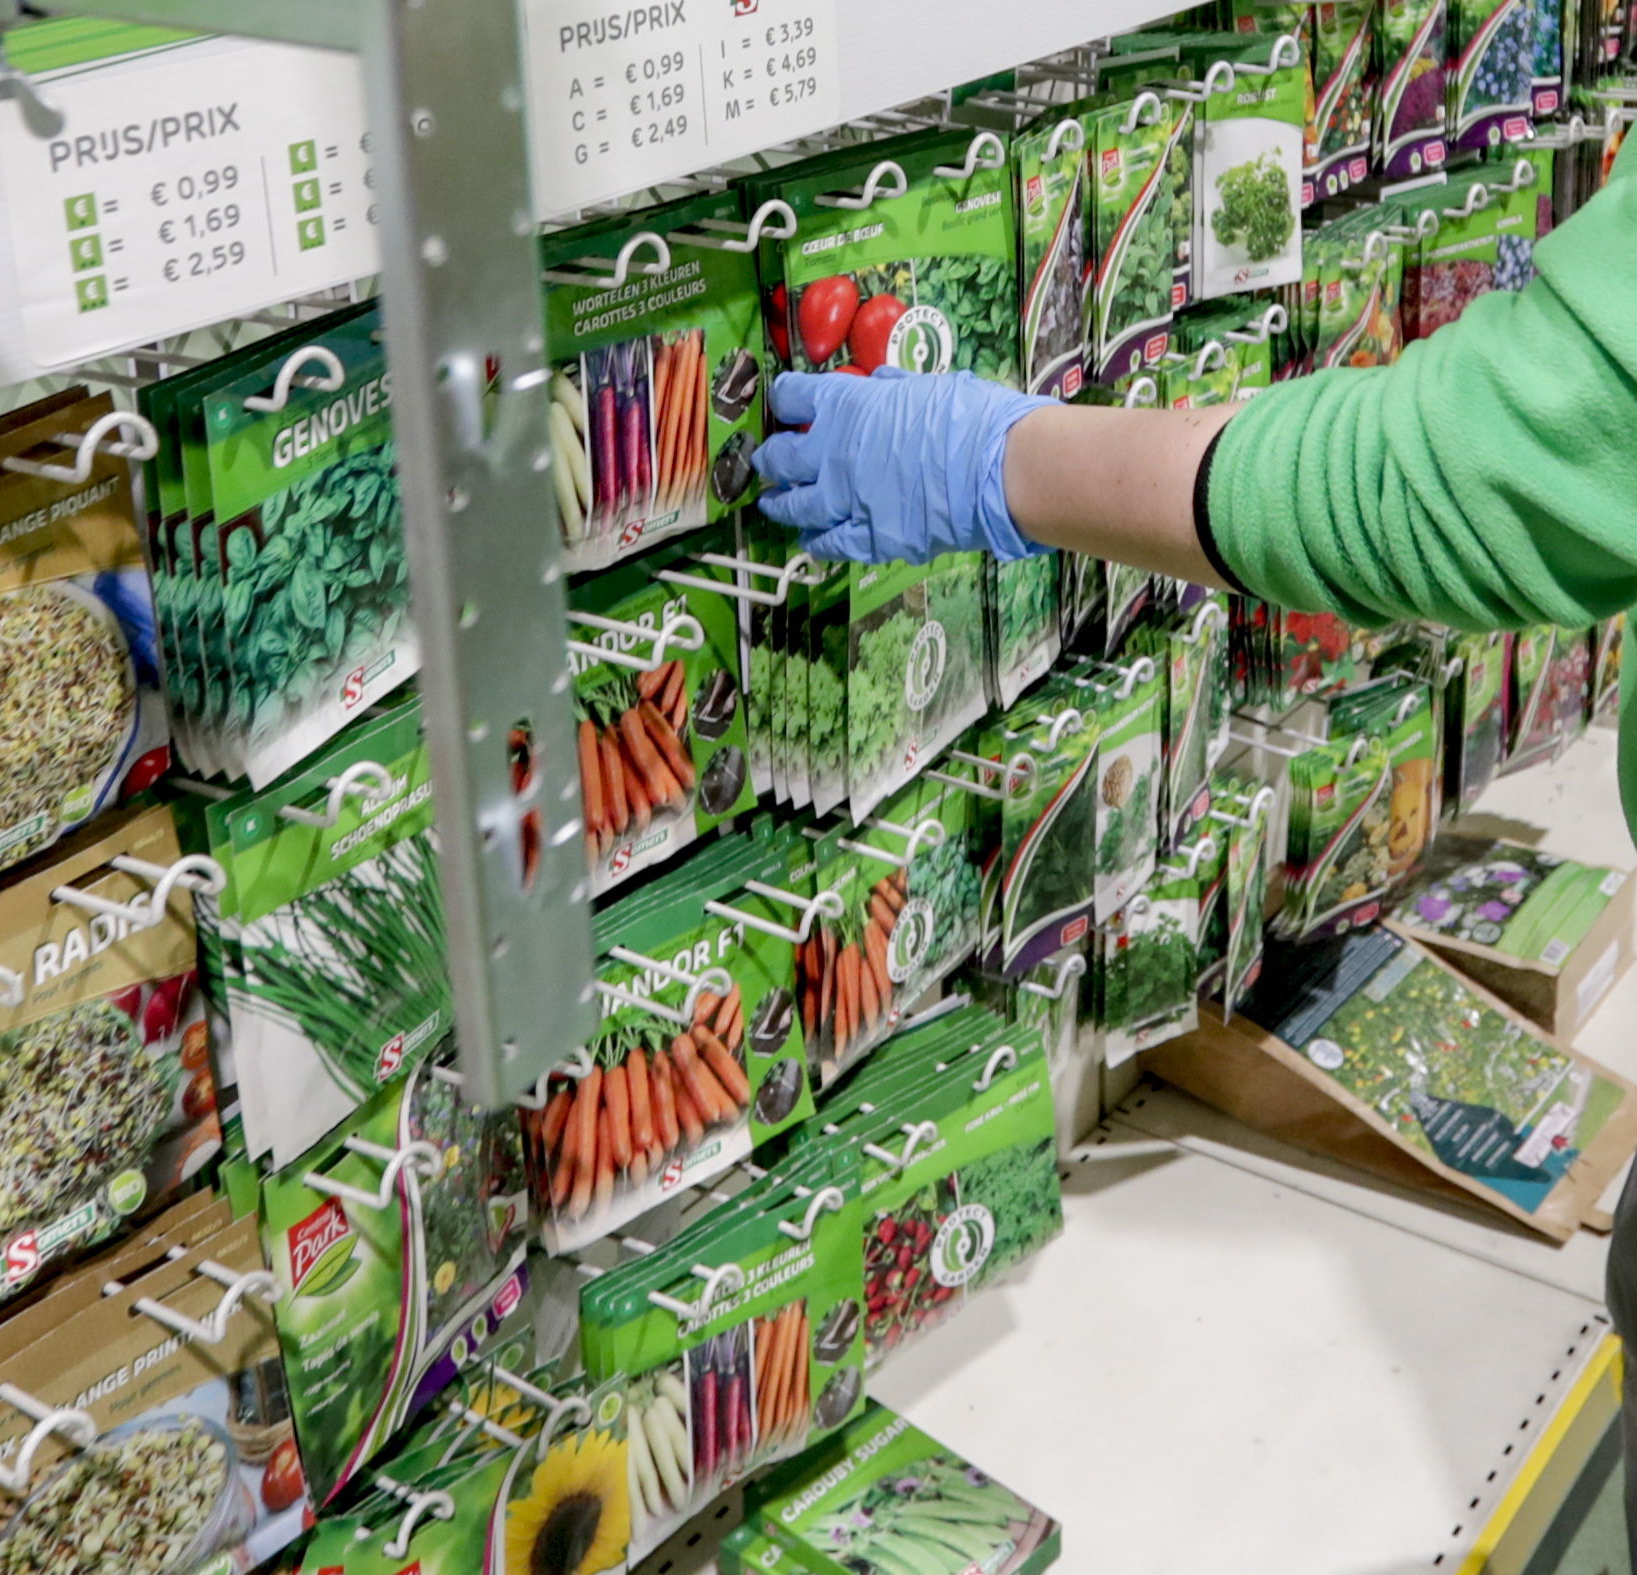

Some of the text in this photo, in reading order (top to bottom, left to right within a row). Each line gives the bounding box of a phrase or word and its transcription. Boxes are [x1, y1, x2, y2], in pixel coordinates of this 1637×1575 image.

[765, 26, 776, 46] €
[780, 16, 814, 44] 3,39
[569, 51, 684, 100] A € 0,99
[723, 46, 817, 91] K € 4,69
[571, 83, 685, 132] C € 1,69
[725, 76, 817, 121] M € 5,79
[49, 102, 241, 173] PRIJS/PRIX
[574, 114, 688, 165] G € 2,49
[150, 182, 169, 207] €
[177, 165, 240, 201] 0,99
[157, 220, 177, 245] €
[183, 203, 241, 241] 1,69
[162, 259, 181, 283] €
[187, 240, 247, 279] 2,59
[572, 284, 640, 317] WORTELEN
[649, 260, 700, 291] KLEUREN
[573, 305, 637, 337] CAROTTES
[647, 278, 707, 312] COULEURS
[892, 310, 945, 346] PROTECT
[273, 372, 394, 469] GENOVES
[50, 475, 120, 524] PIQUANT
[361, 772, 408, 818] ALUM
[718, 919, 745, 959] F1
[662, 1141, 723, 1192] Somers
[292, 1204, 348, 1278] Park
[935, 1209, 987, 1248] PROTECT
[940, 1246, 988, 1283] GARDEN
[54, 1367, 131, 1414] LANGE
[781, 1417, 912, 1523] CAROUBY SUGAR
